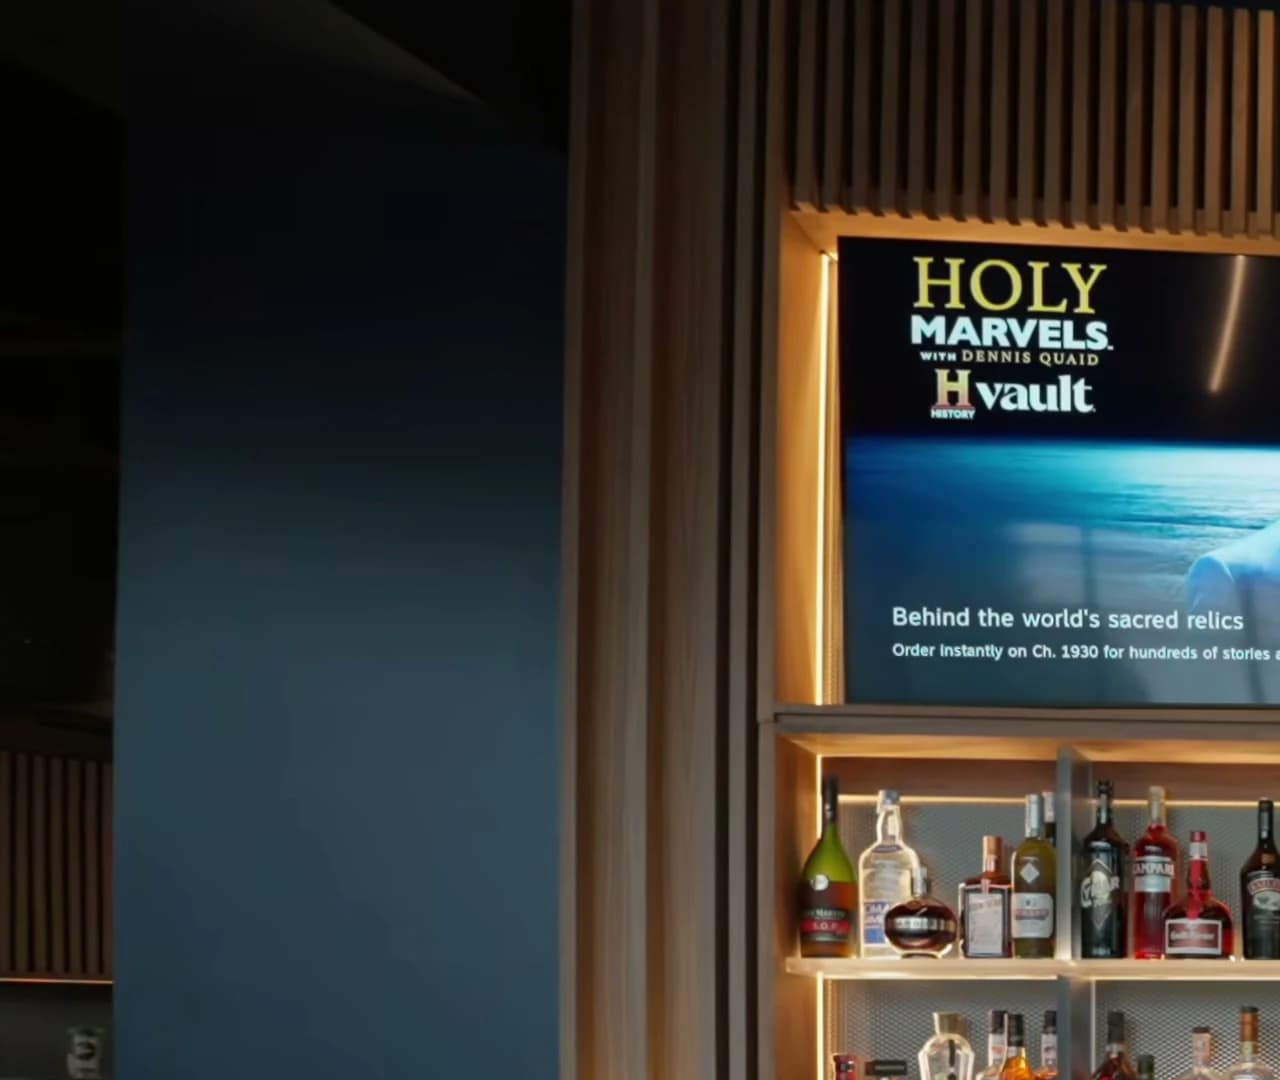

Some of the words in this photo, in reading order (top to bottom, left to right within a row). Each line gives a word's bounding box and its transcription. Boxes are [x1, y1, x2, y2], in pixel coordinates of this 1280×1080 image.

[913, 256, 1107, 315] HOLY
[920, 351, 957, 362] WITH
[961, 350, 1031, 364] DENNIS
[1039, 352, 1099, 367] QUAID
[975, 374, 1095, 414] vault
[930, 408, 976, 420] HISTORY
[892, 606, 970, 627] Behind
[977, 607, 1014, 628] the
[1022, 608, 1101, 629] world's
[1108, 610, 1179, 630] sacred
[1187, 611, 1245, 630] relics
[892, 643, 935, 657] Order
[1008, 646, 1028, 658] on
[1032, 644, 1056, 658] Ch.
[1061, 645, 1099, 659] 1930
[1103, 645, 1125, 659] for
[1128, 646, 1198, 660] hundreds
[1202, 646, 1219, 660] of
[1223, 647, 1271, 661] stories
